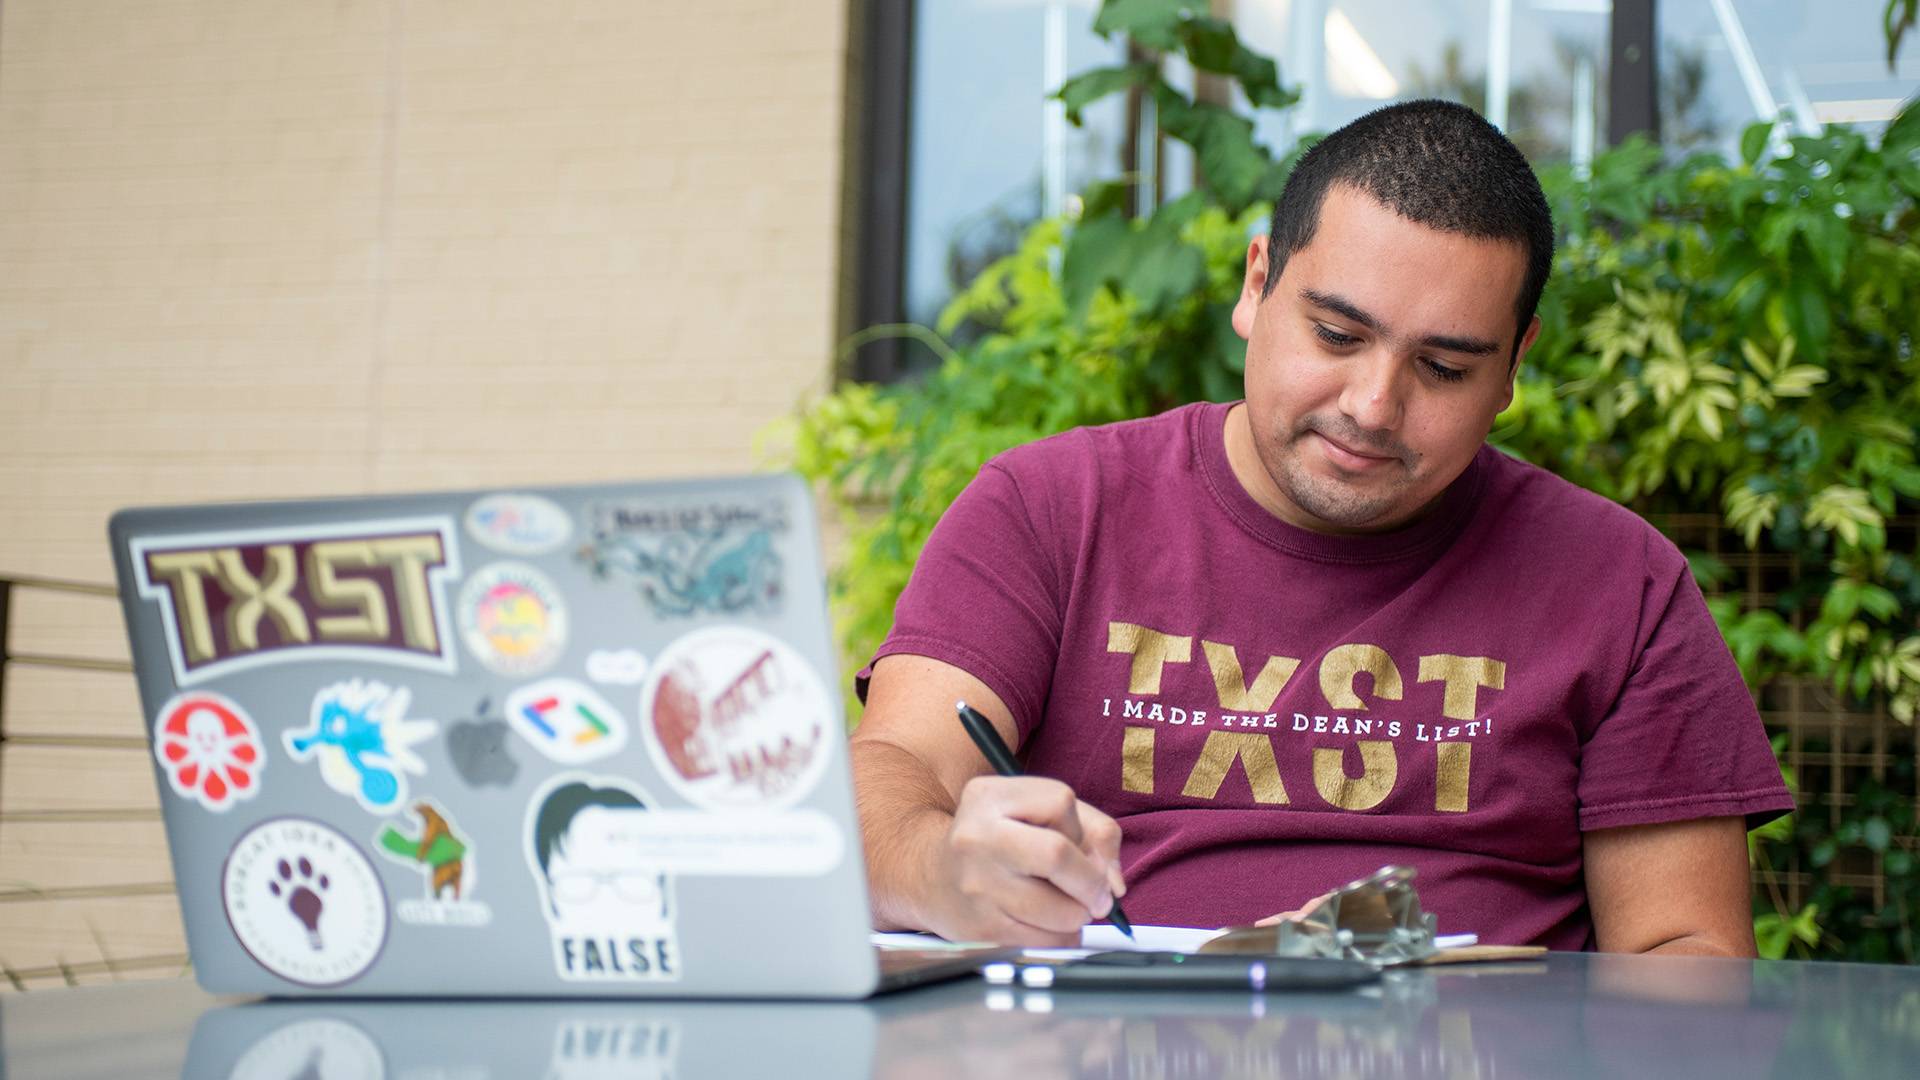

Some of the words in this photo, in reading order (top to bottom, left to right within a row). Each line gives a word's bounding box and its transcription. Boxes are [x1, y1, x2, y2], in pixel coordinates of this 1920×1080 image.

[149, 533, 443, 663] TXST
[1103, 699, 1111, 717] I
[1122, 700, 1206, 726] MADE
[1221, 713, 1278, 728] THE
[1416, 719, 1492, 741] LIST!
[1107, 622, 1506, 812] TXST
[562, 937, 673, 973] FALSE
